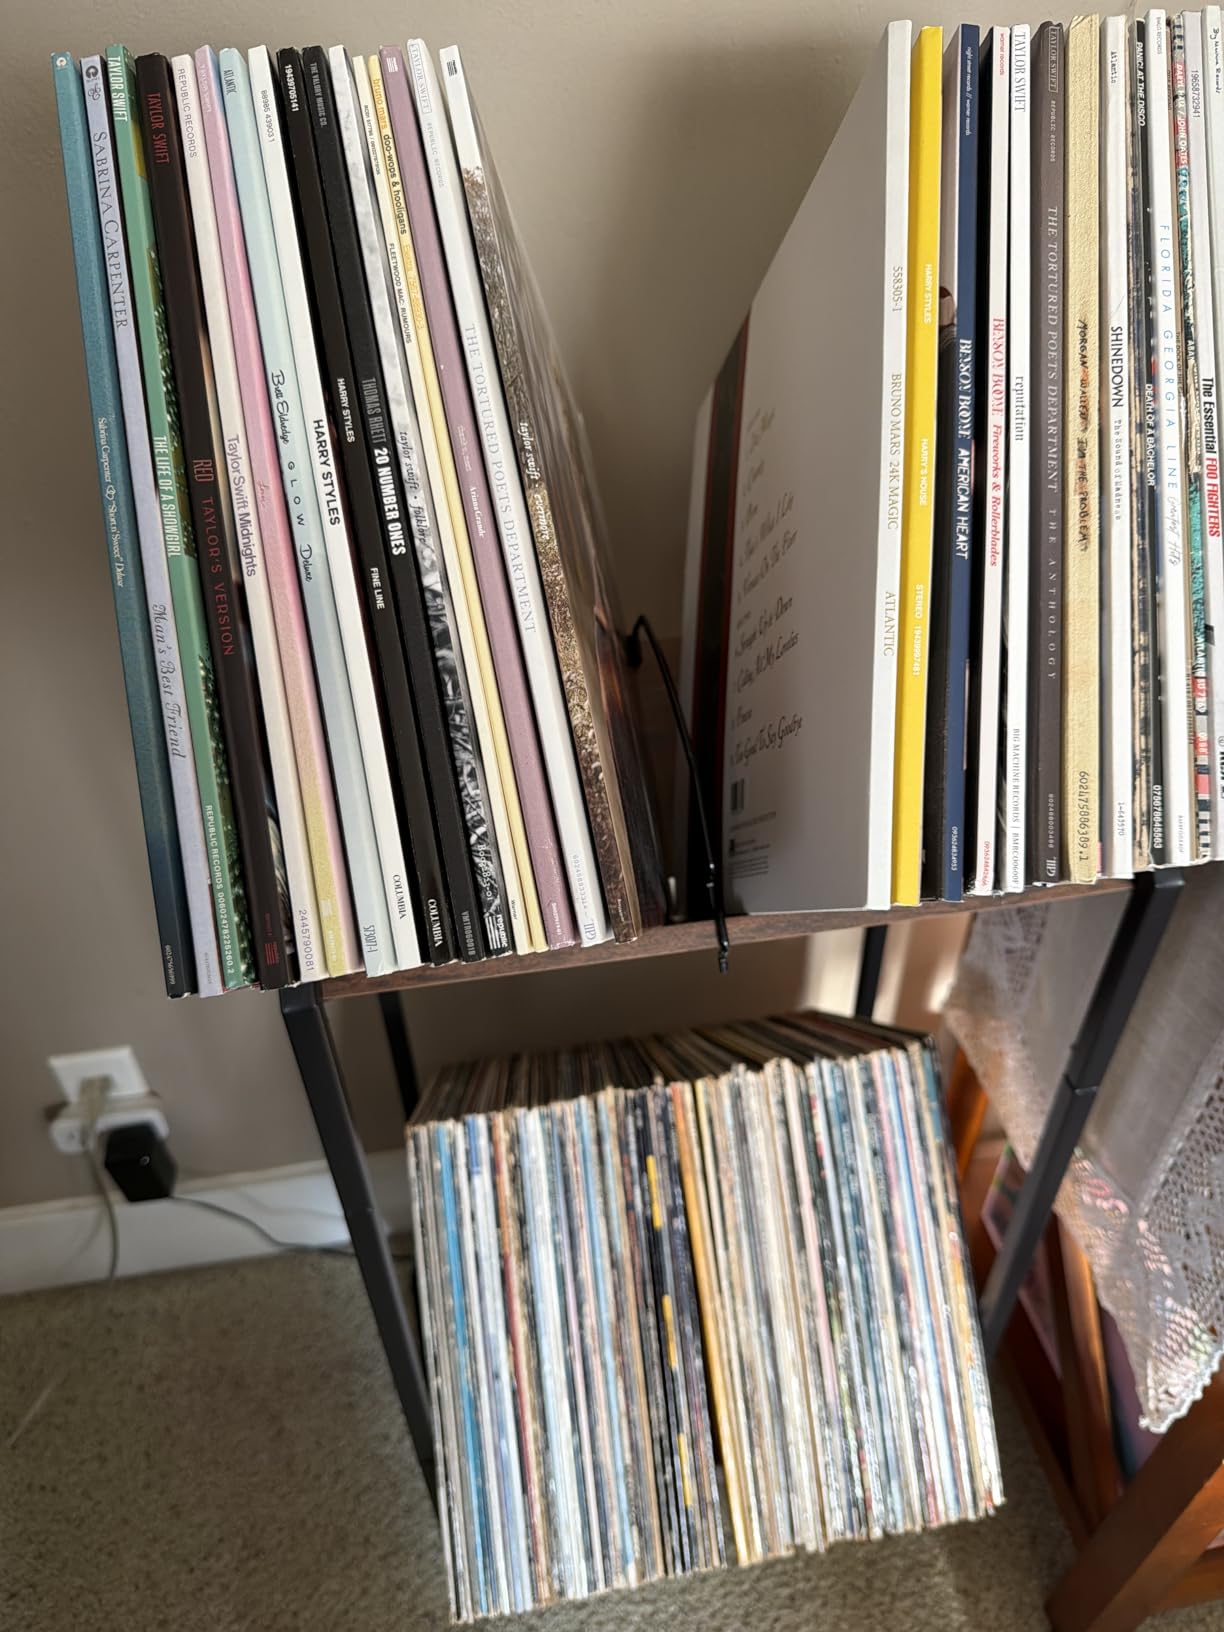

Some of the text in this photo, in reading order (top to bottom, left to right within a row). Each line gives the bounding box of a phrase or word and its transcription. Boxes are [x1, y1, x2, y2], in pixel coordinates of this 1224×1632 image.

[410, 48, 430, 110] TAYLOR SWIFT
[1014, 32, 1026, 113] TAYLOR SWIFT
[1049, 30, 1058, 63] TAYLOR
[1050, 64, 1058, 90] SWIFT
[1110, 51, 1118, 84] Atlantic
[1136, 42, 1144, 69] PANIC!
[1136, 70, 1144, 80] AT
[107, 56, 128, 122] TAYLOR SWIFT
[178, 68, 197, 158] REPUBLIC RECORDS
[223, 69, 236, 95] ATLANTIC
[260, 90, 274, 138] 88985 43903
[284, 64, 299, 112] 19439705141
[310, 63, 318, 74] THE
[314, 98, 325, 116] MUSIC
[1138, 100, 1146, 127] DISCO
[1176, 64, 1188, 164] DARYL JOHN OATES
[1191, 70, 1201, 118] 19658732941
[146, 92, 170, 165] TAYLOR SWIFT
[372, 78, 384, 105] bruno
[378, 107, 388, 130] mars
[383, 134, 398, 178] doo-wops
[393, 190, 408, 235] hooligans
[426, 122, 444, 188] REPUBLIC RECORDS
[93, 131, 129, 329] SABRINA CARPENTER
[389, 243, 412, 344] FLEETWOOD MAC: RUMOURS
[1160, 226, 1172, 313] FLORIDA
[1110, 326, 1124, 408] SHINEDOWN
[1162, 330, 1176, 427] GEORGIA
[337, 378, 355, 443] HARRY STYLES
[914, 264, 932, 620] HARRY STYLES HOUSE STEREO
[990, 318, 1004, 566] BENSON BOONE Fireworks & Rollerblades
[1012, 376, 1026, 442] reputation
[1047, 206, 1058, 680] THE TORTURED POETS DEPARTMENT THE ANTHOLOGY
[1077, 320, 1090, 544] MORGAN WALLEN THE PROBLEM
[1114, 419, 1122, 436] The
[1144, 384, 1156, 486] DEATH OF A BACHELOR
[98, 418, 112, 482] Sabrina Carpenter
[153, 436, 168, 454] THE
[156, 456, 171, 476] LIFE
[271, 370, 313, 583] Brett Eldredge Deluxe
[313, 419, 340, 526] HARRY STYLES
[361, 378, 406, 556] THOMAS RHETT 20 NUMBER ONES
[464, 324, 536, 634] THE TORTURED POETS DEPARTMENT
[883, 266, 903, 657] 558305-1 BRUNO MARS 24K MAGIC ATLANTIC
[956, 338, 972, 560] BENSON BOONE AMERICAN HEART
[1114, 438, 1122, 466] Sound
[1166, 445, 1178, 489] LINE
[1202, 378, 1220, 538] The Essential FOO FIGHTERS
[158, 479, 173, 492] OF
[226, 435, 258, 577] Taylor Swift Midnights
[396, 432, 430, 548] taylor swift folklore
[468, 486, 486, 538] Ariana Grande
[517, 422, 550, 540] taylor swift evermore
[162, 503, 180, 558] SHOWGIRL
[192, 459, 214, 482] RED
[214, 582, 234, 656] VERSION
[370, 567, 385, 610] FINE LINE
[152, 604, 186, 758] Man's Best Friend
[1012, 728, 1020, 822] BIG MACHINE RECORDS
[204, 805, 223, 890] REPUBLIC RECORDS
[392, 874, 407, 920] COLUMBIA
[428, 899, 443, 948] COLUMBIA
[298, 910, 314, 970] 2445790081
